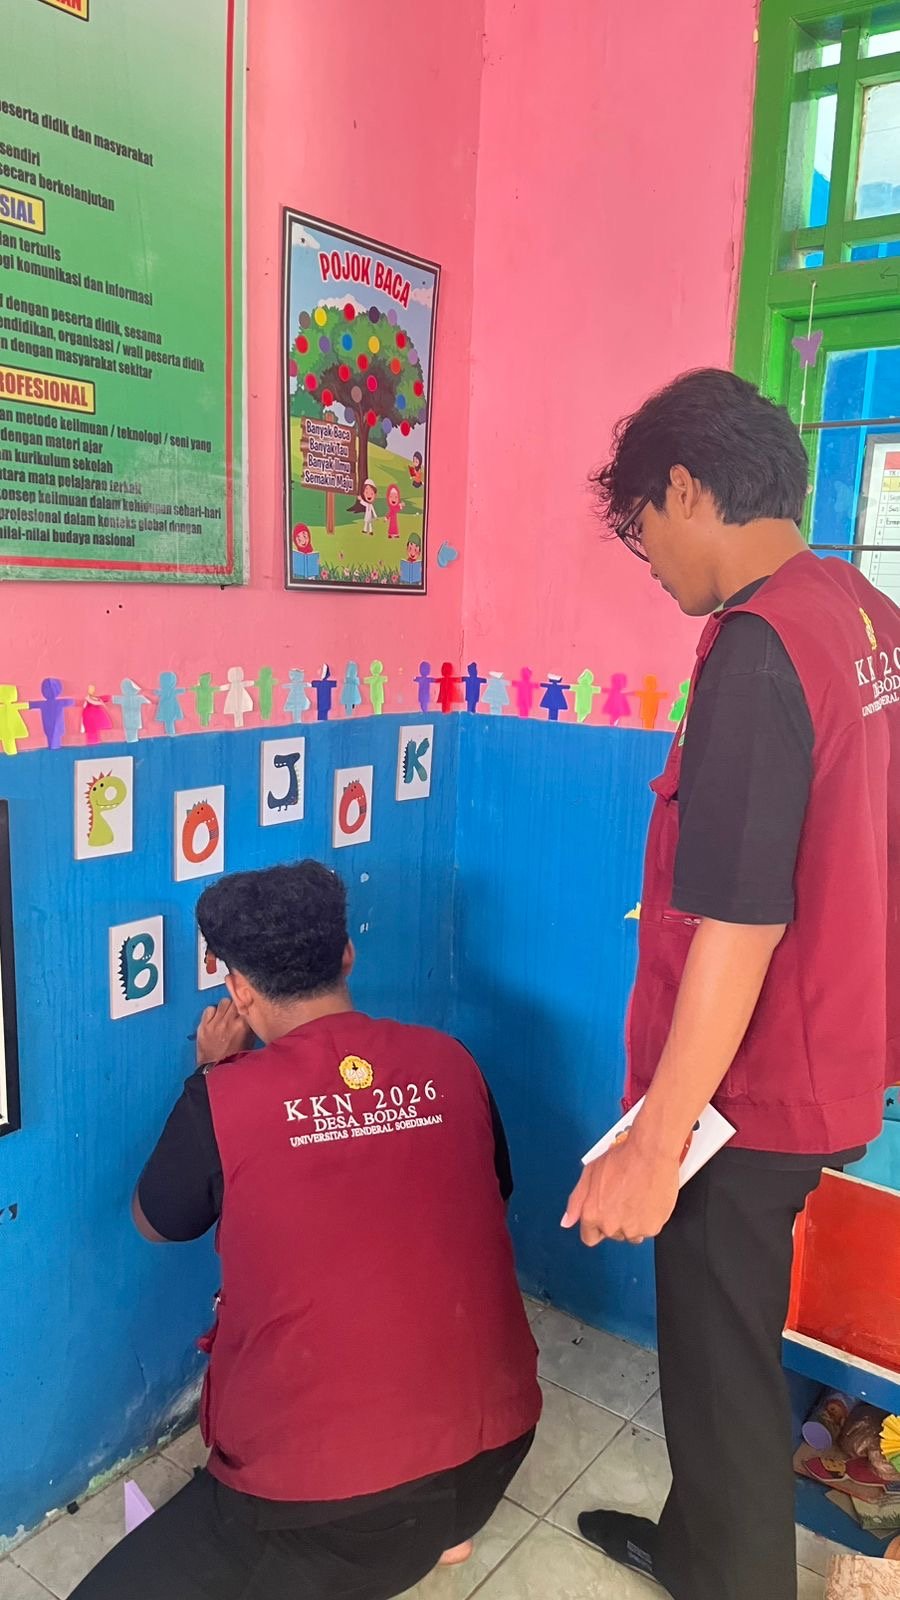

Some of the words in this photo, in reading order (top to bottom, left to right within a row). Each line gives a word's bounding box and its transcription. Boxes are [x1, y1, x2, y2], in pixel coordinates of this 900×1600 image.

[0, 100, 39, 125] eserta
[41, 113, 69, 136] didik
[71, 125, 92, 144] dan
[94, 134, 153, 167] masyarakat
[0, 141, 40, 166] sendiri
[39, 173, 115, 211] berkelanjutan
[19, 237, 61, 261] tertulis
[17, 255, 81, 287] komunikasi
[84, 276, 103, 292] dan
[105, 281, 153, 306] informasi
[319, 251, 371, 286] POJOK
[374, 261, 411, 308] BACA
[6, 295, 49, 318] dengan
[52, 306, 93, 328] peserta
[95, 317, 122, 337] didik,
[124, 325, 162, 345] sesama
[10, 337, 53, 359] dengan
[55, 348, 117, 373] masyarakat
[118, 361, 153, 379] sekitar
[58, 329, 114, 353] organisasi
[123, 342, 143, 359] wali
[145, 349, 181, 368] peserta
[182, 355, 205, 372] didik
[1, 427, 43, 446] dengan
[45, 435, 80, 451] materi
[83, 440, 103, 454] ajar
[16, 411, 58, 429] metode
[60, 416, 108, 437] keilmuan
[117, 426, 162, 445] teknologi
[170, 435, 189, 449] seni
[191, 438, 212, 453] yang
[306, 420, 332, 438] Banyak
[333, 425, 351, 441] Baca
[309, 438, 335, 455] Banyak
[15, 448, 71, 469] kurikulum
[73, 457, 113, 474] sekolah
[308, 454, 334, 471] Banyak
[28, 471, 56, 486] mata
[58, 474, 108, 491] pelajaran
[305, 470, 336, 486] Semakin
[336, 475, 353, 491] Maju
[38, 490, 88, 508] keilmuan
[90, 495, 121, 510] dalam
[63, 511, 96, 527] dalam
[98, 514, 137, 530] konteks
[138, 516, 168, 532] global
[168, 520, 202, 535] dengan
[53, 529, 91, 546] budaya
[92, 532, 135, 547] nasional
[284, 1093, 354, 1121] KKN
[372, 1080, 436, 1109] 2026
[290, 1130, 349, 1147] UNIVERSITAS
[351, 1122, 394, 1138] JENDERAL
[395, 1114, 443, 1131] SOEDIRMAN
[314, 1113, 360, 1132] DESA
[363, 1105, 418, 1125] BODAS
